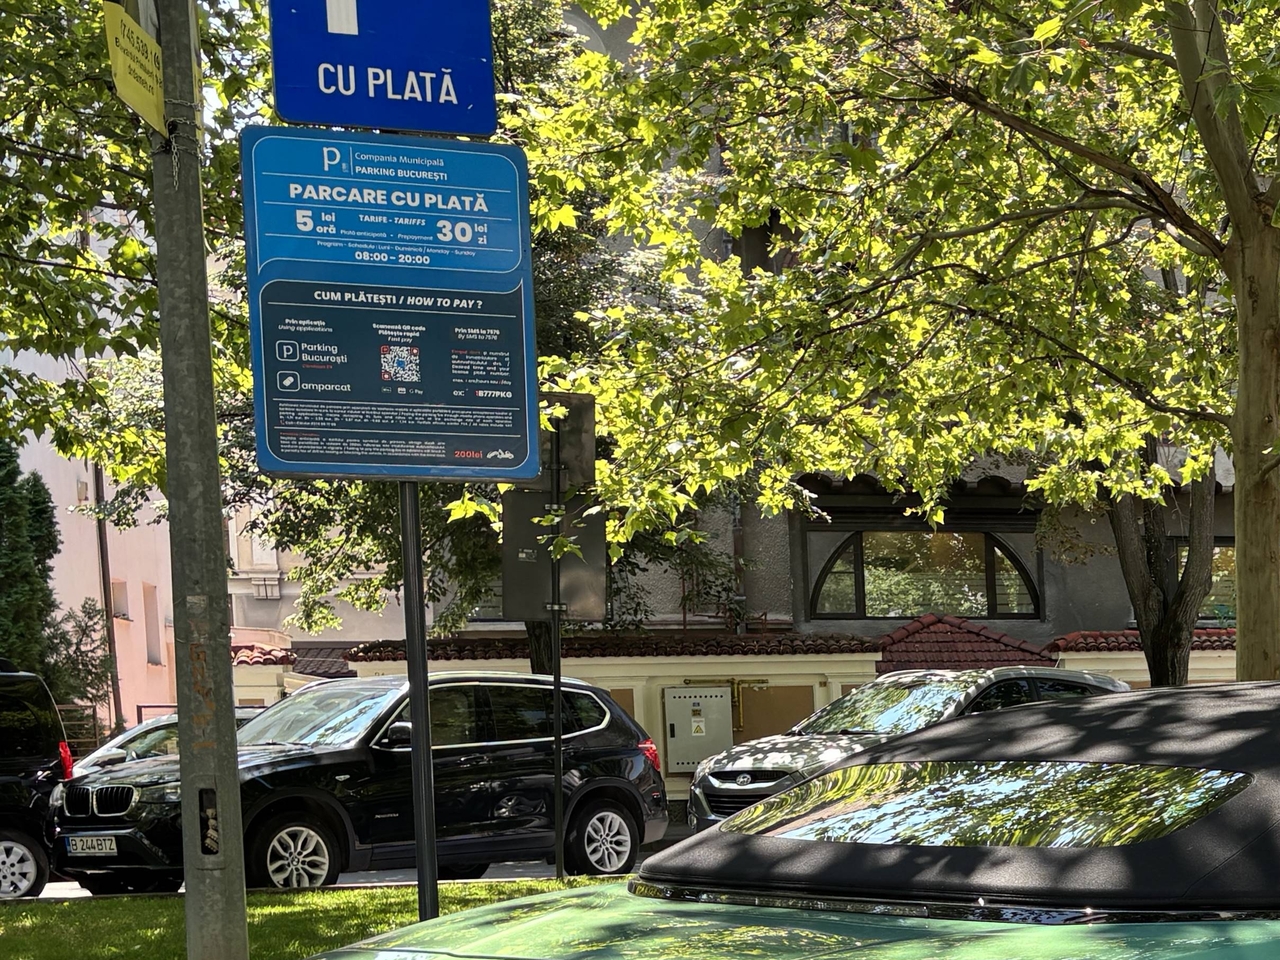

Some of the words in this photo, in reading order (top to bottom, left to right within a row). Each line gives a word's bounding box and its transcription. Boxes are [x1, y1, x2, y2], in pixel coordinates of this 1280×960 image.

[318, 63, 355, 96] CU
[367, 67, 458, 105] PLATĂ
[355, 151, 397, 164] Compania
[398, 155, 444, 167] Municipală
[355, 166, 396, 177] PARKING
[289, 183, 387, 204] PARCARE
[390, 191, 421, 207] CU
[424, 192, 489, 213] PLATĂ
[295, 209, 314, 232] 5
[321, 212, 336, 223] lei
[358, 215, 388, 225] TARIFE
[394, 217, 426, 227] TARIFFS
[316, 223, 337, 234] oră
[436, 219, 473, 243] 30
[474, 223, 488, 233] lei
[477, 236, 487, 245] zi
[355, 251, 388, 262] 08:00
[398, 254, 431, 265] 20:00
[314, 291, 341, 301] CUM
[344, 291, 396, 305] PLĂTEȘTI
[399, 296, 405, 305] /
[407, 297, 434, 306] HOW
[436, 298, 451, 307] TO
[453, 299, 475, 309] PAY
[476, 301, 483, 309] ?
[301, 343, 338, 354] Parking
[301, 381, 351, 392] amparcat
[71, 838, 78, 851] B
[80, 838, 96, 851] 244
[96, 838, 115, 851] BTZ
